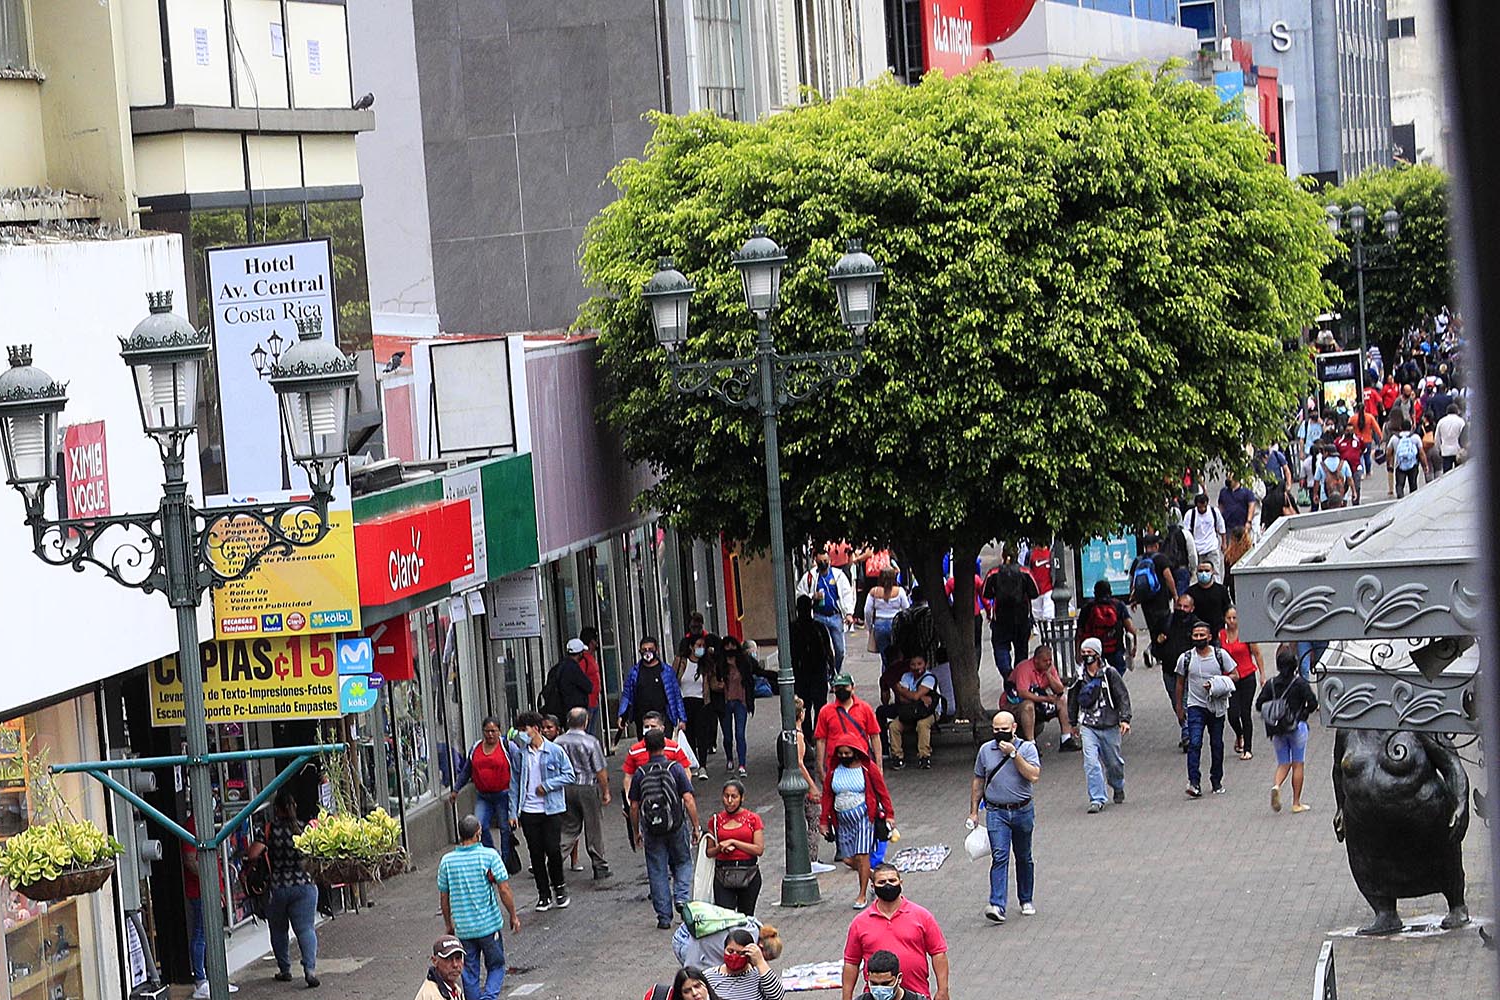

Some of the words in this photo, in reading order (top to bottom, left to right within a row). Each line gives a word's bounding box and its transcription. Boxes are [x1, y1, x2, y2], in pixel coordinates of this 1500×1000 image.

[1271, 20, 1292, 53] S
[245, 255, 295, 274] Hotel
[220, 283, 248, 300] Av.
[253, 274, 324, 296] Central
[224, 305, 275, 325] Costa
[283, 301, 323, 320] Rica
[71, 480, 106, 515] VOGUE
[276, 553, 335, 563] Presentación
[389, 546, 421, 591] Claro
[265, 601, 312, 609] Publicidad
[154, 637, 273, 685] CPIAS
[208, 689, 218, 699] de
[294, 700, 338, 715] Empastes
